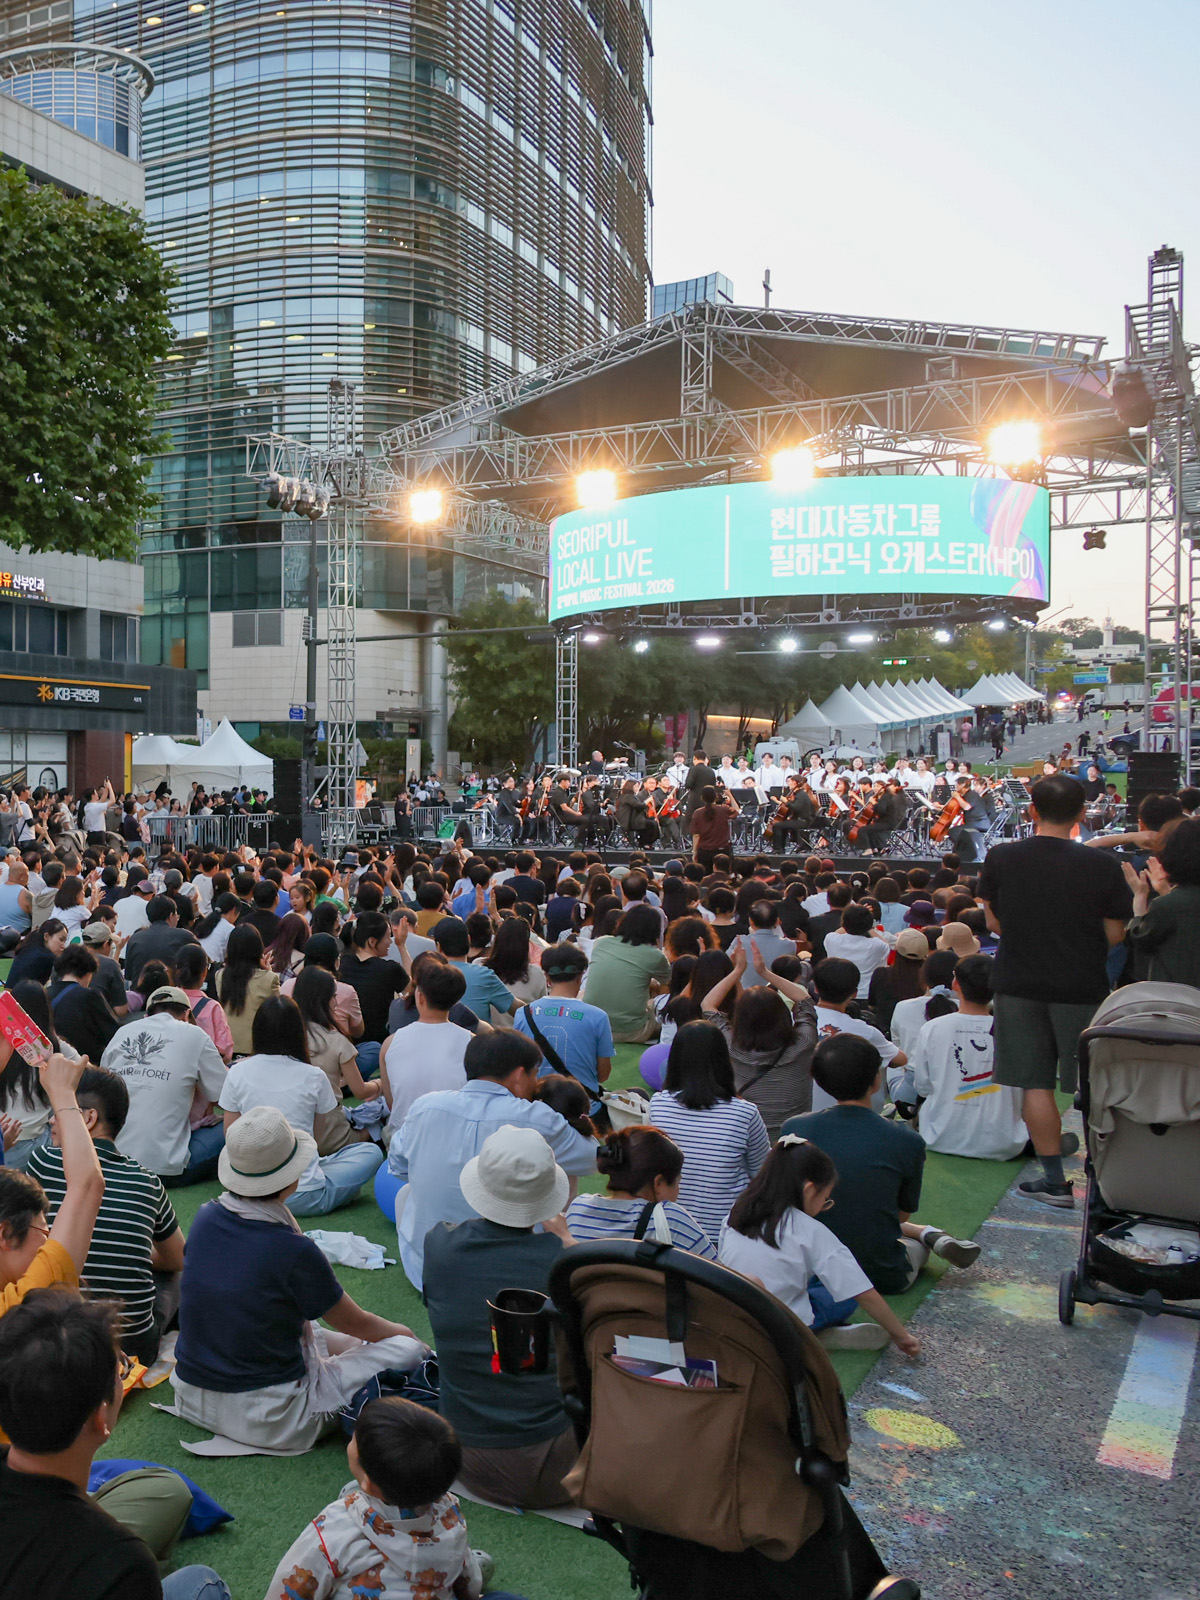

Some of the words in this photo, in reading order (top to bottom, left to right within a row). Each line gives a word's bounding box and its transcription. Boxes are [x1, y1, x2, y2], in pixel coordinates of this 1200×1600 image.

[557, 519, 636, 560] SEORIPUL
[770, 504, 941, 540] 현대자동차그룹
[557, 557, 601, 591] LOCAL
[605, 547, 653, 581] LIVE
[769, 541, 872, 577] 필하모닉
[877, 541, 1036, 580] 오케스트라(HPO)
[13, 574, 45, 592] 산부인과
[604, 582, 644, 600] FESTIVAL
[646, 578, 675, 595] 2026
[54, 687, 100, 703] KB국민은행
